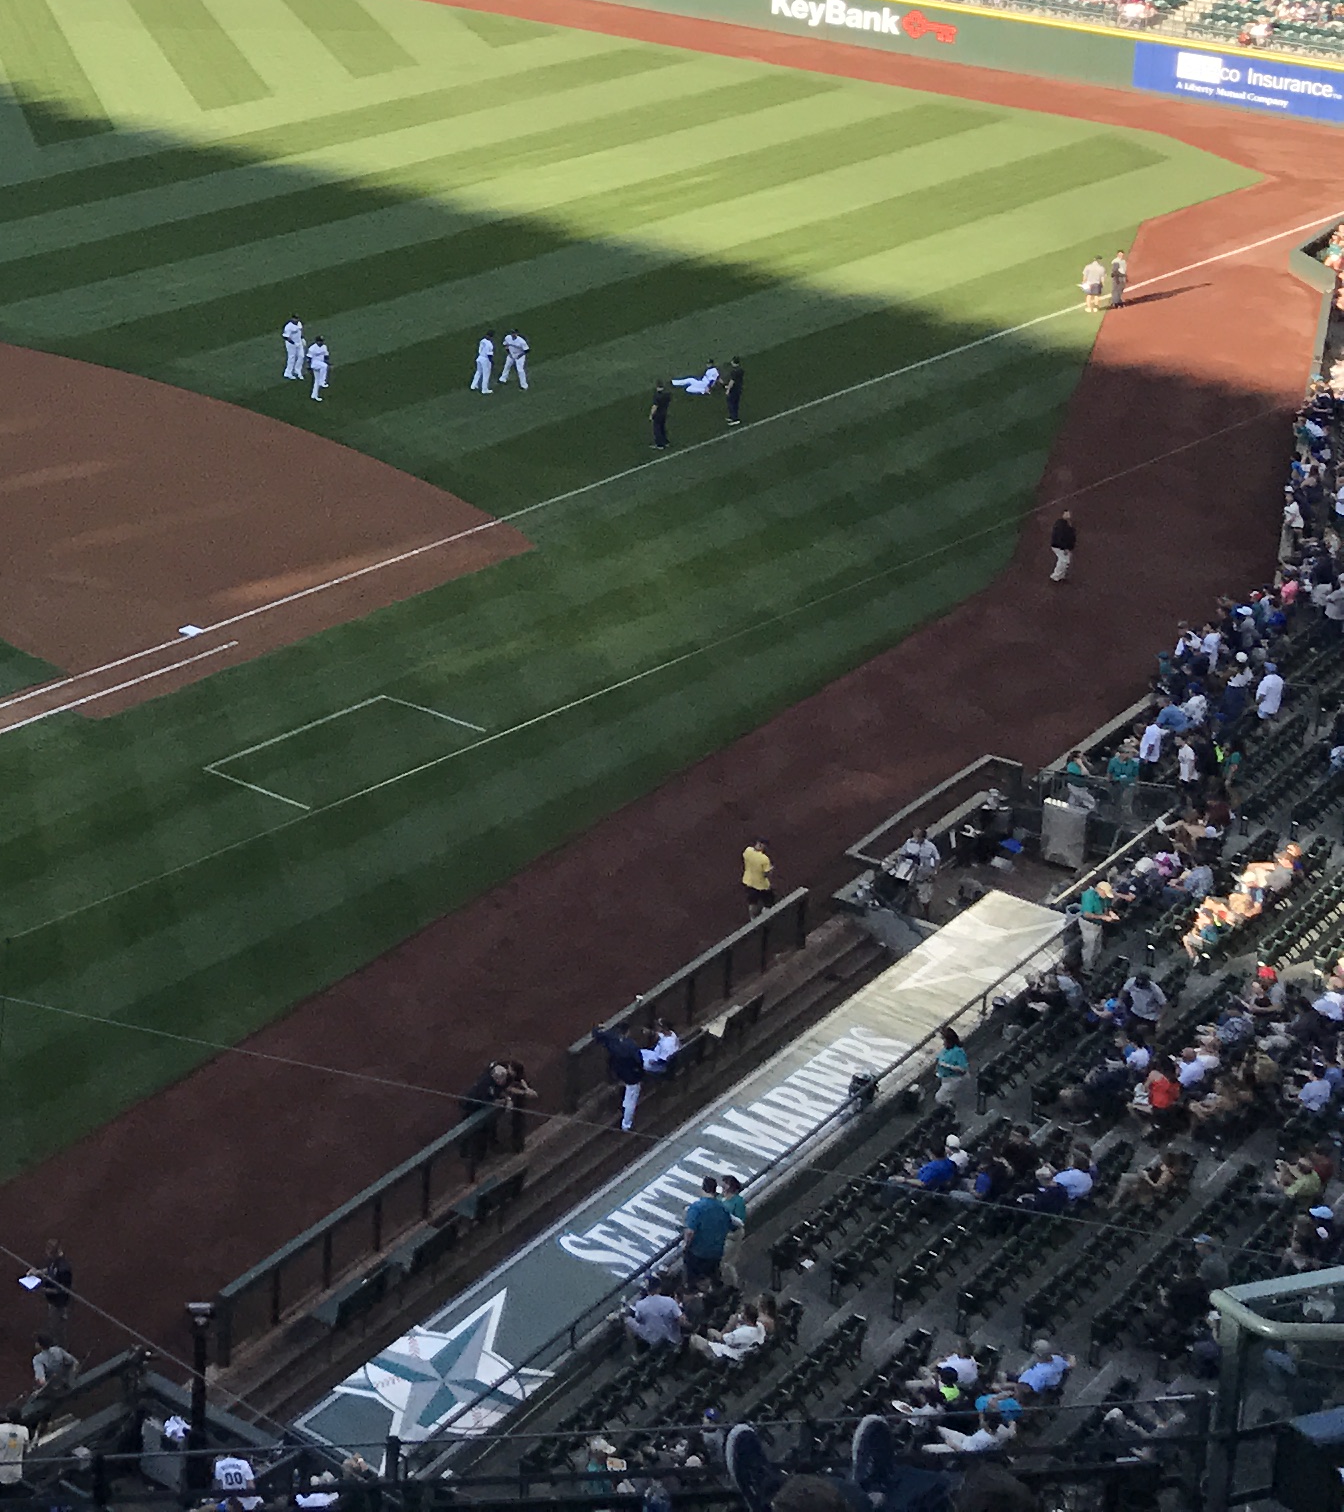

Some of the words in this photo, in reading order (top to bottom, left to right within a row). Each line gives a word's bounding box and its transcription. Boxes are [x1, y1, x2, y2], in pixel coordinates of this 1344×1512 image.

[1184, 83, 1214, 96] Liberty
[1216, 88, 1246, 100] Mutual
[1247, 93, 1289, 108] Company
[1248, 67, 1333, 98] Insurance
[559, 1146, 758, 1279] SEATTLE
[702, 1026, 913, 1162] MARINERS
